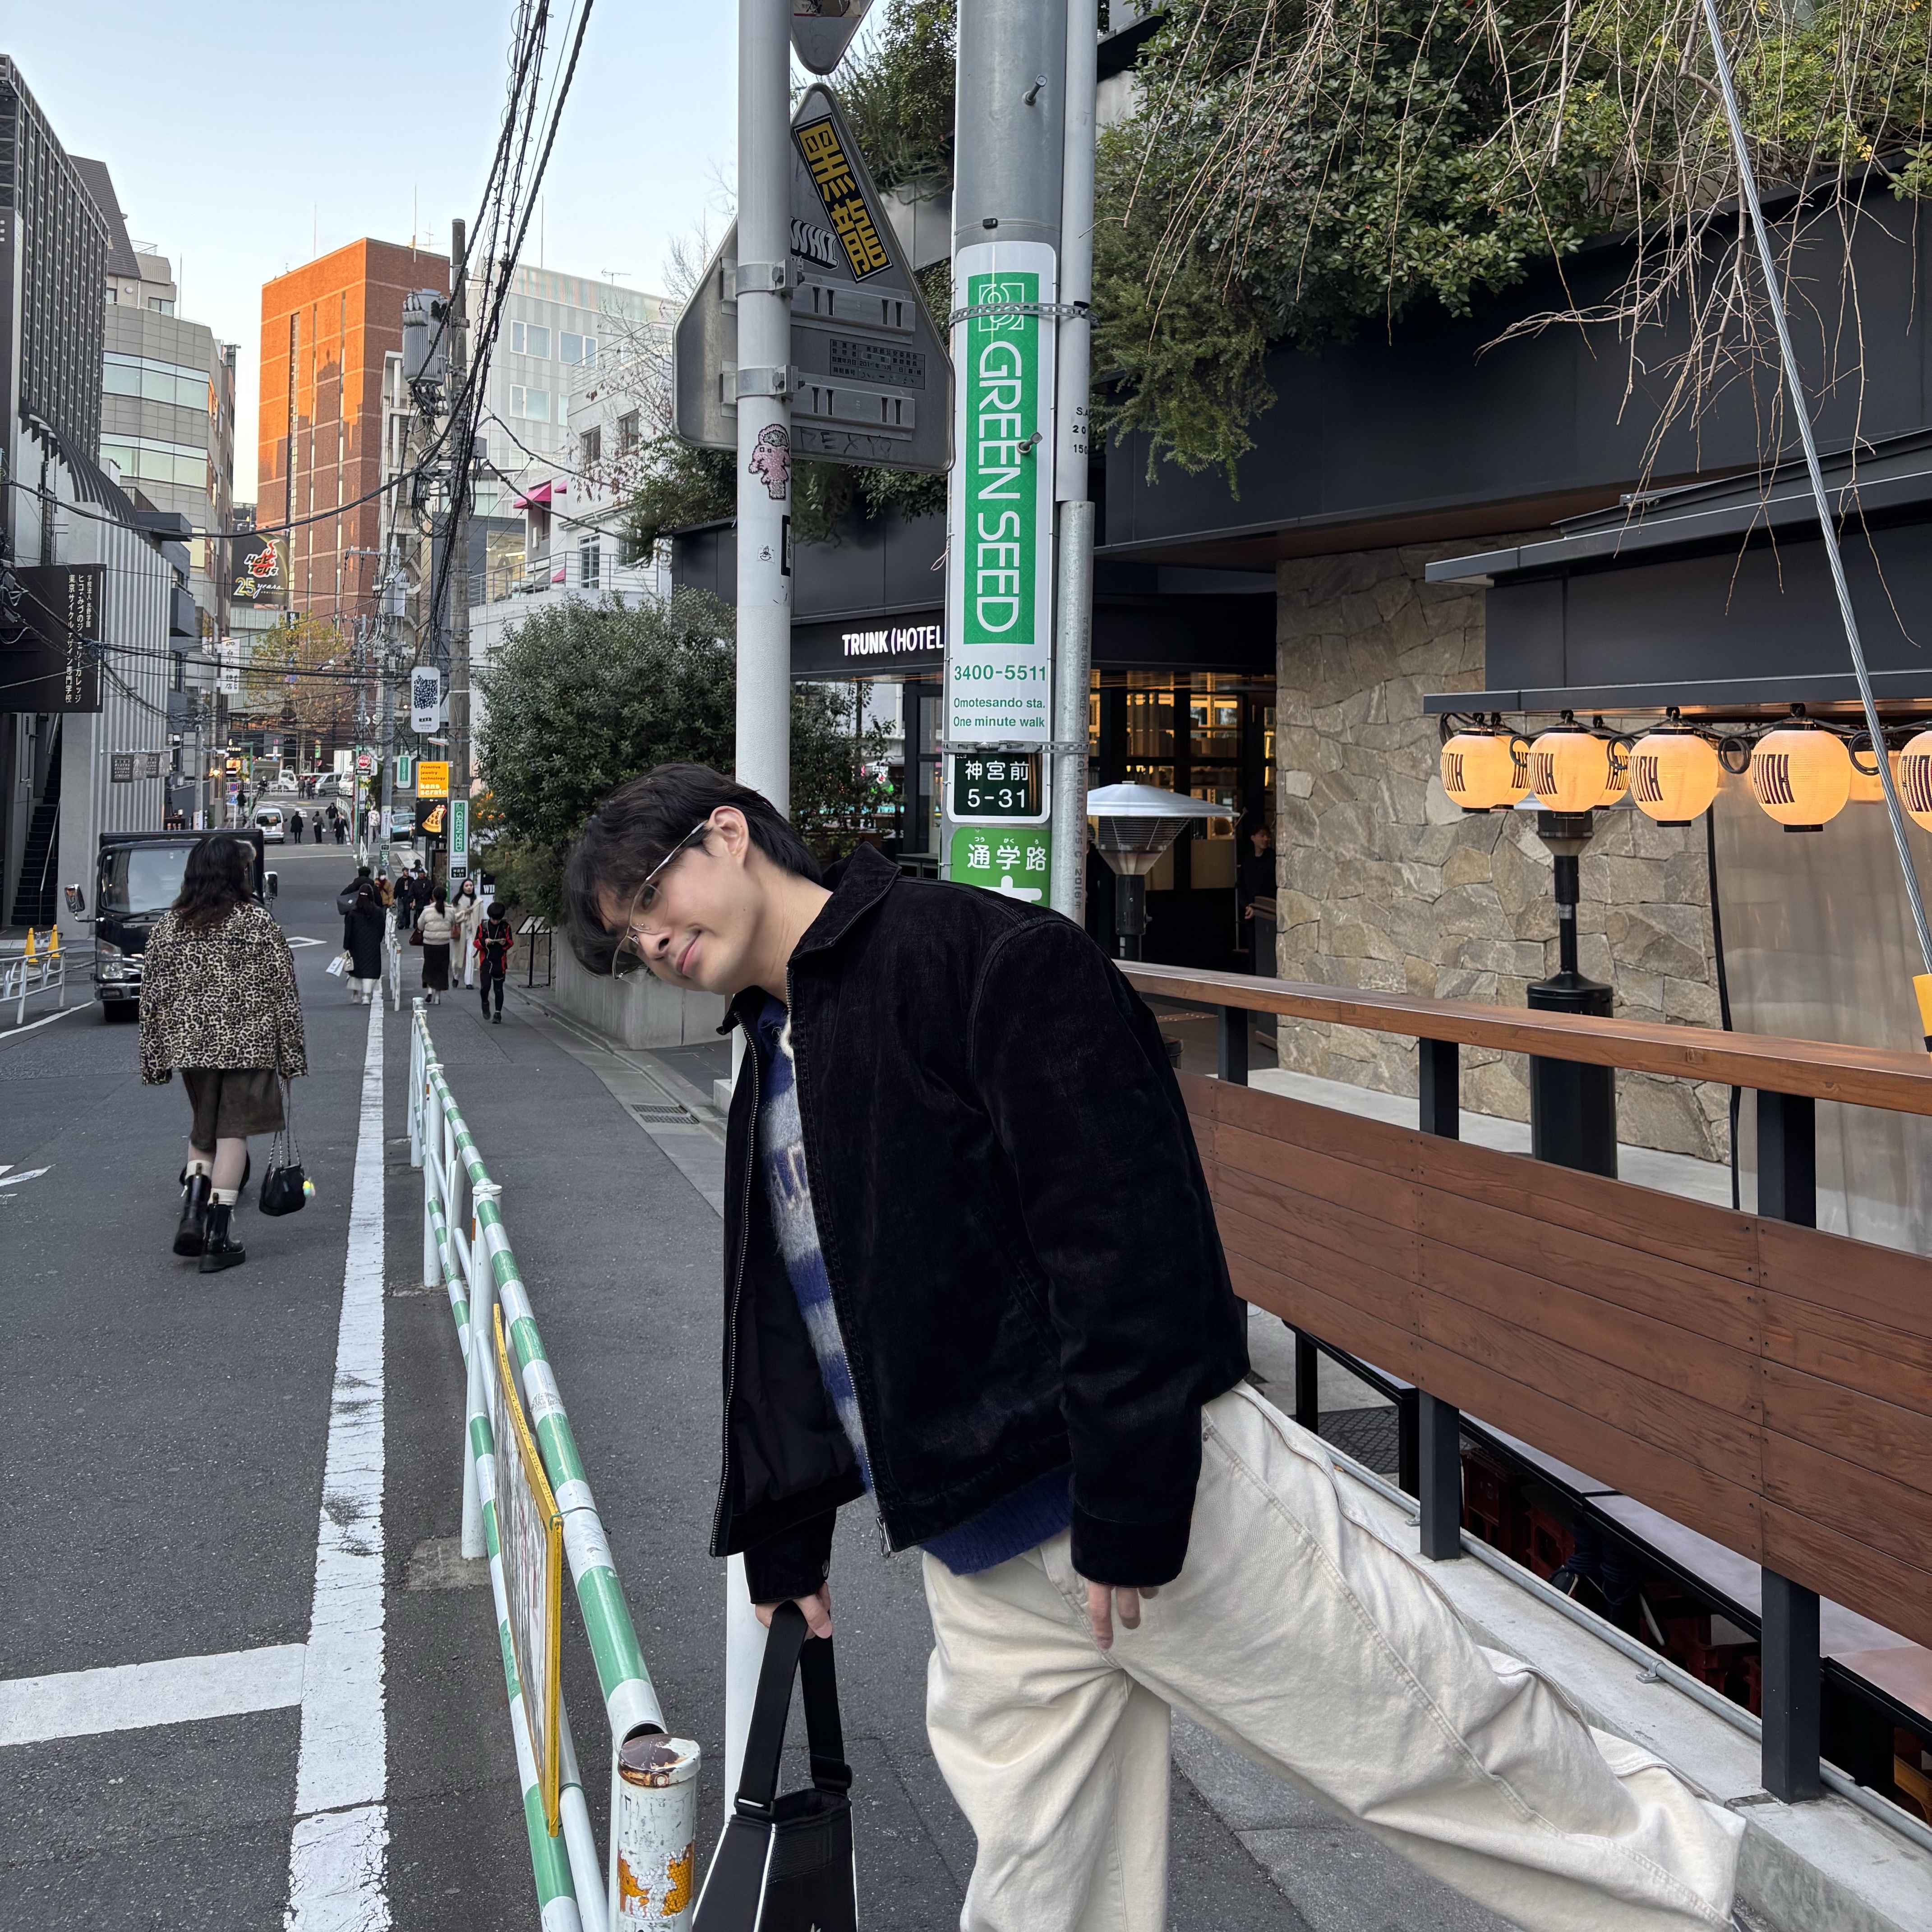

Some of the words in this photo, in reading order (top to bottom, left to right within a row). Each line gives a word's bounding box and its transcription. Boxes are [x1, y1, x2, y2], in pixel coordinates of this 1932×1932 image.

[798, 121, 887, 276] 黒龍
[978, 341, 1021, 499] GREEN
[977, 511, 1019, 632] SEED
[233, 577, 256, 597] 25
[954, 665, 1046, 681] 3400-5511
[954, 697, 1023, 708] Omotesando
[1026, 699, 1045, 708] sta.
[954, 716, 972, 727] One
[975, 716, 1016, 727] minute
[1019, 717, 1045, 727] walk
[965, 760, 1029, 781] 神宮前
[967, 788, 1025, 808] 5-31
[967, 843, 1047, 871] 通学路
